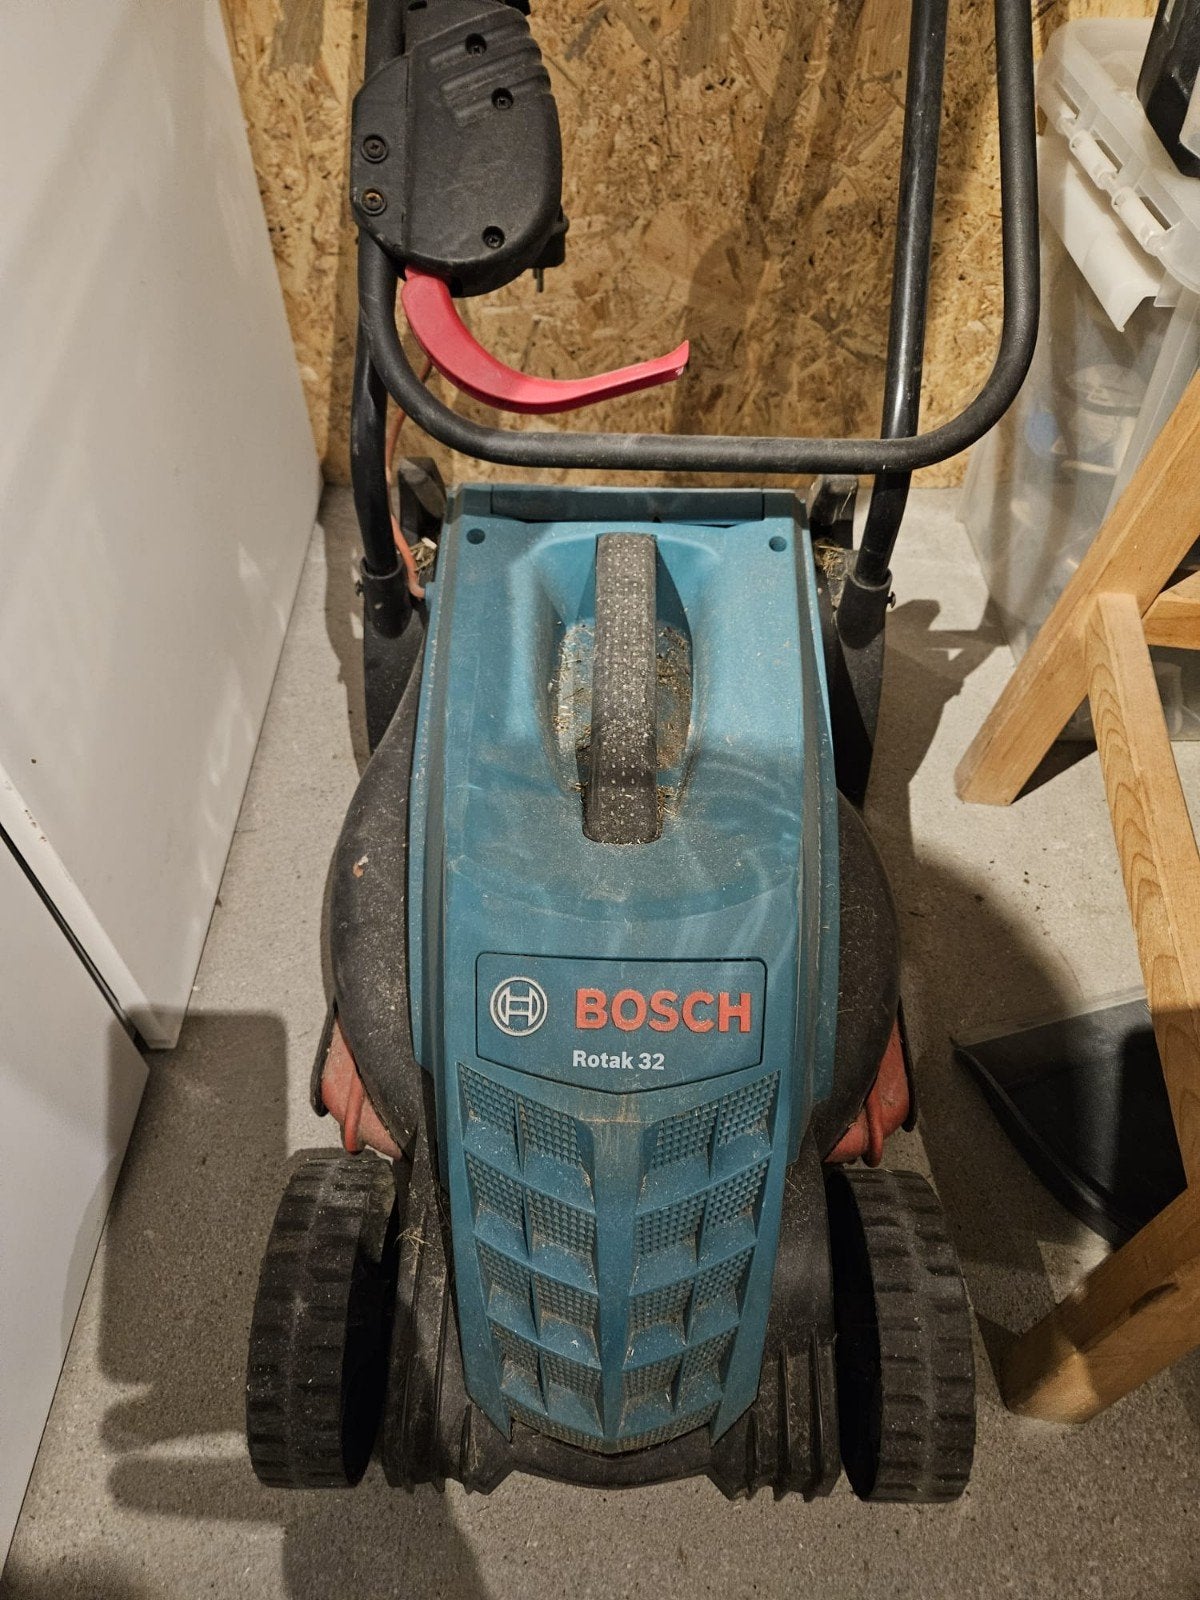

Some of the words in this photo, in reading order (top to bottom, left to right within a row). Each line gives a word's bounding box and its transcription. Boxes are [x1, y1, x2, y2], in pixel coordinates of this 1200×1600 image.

[575, 988, 752, 1033] BOSCH
[572, 1050, 634, 1069] Rotak
[638, 1053, 665, 1070] 32
